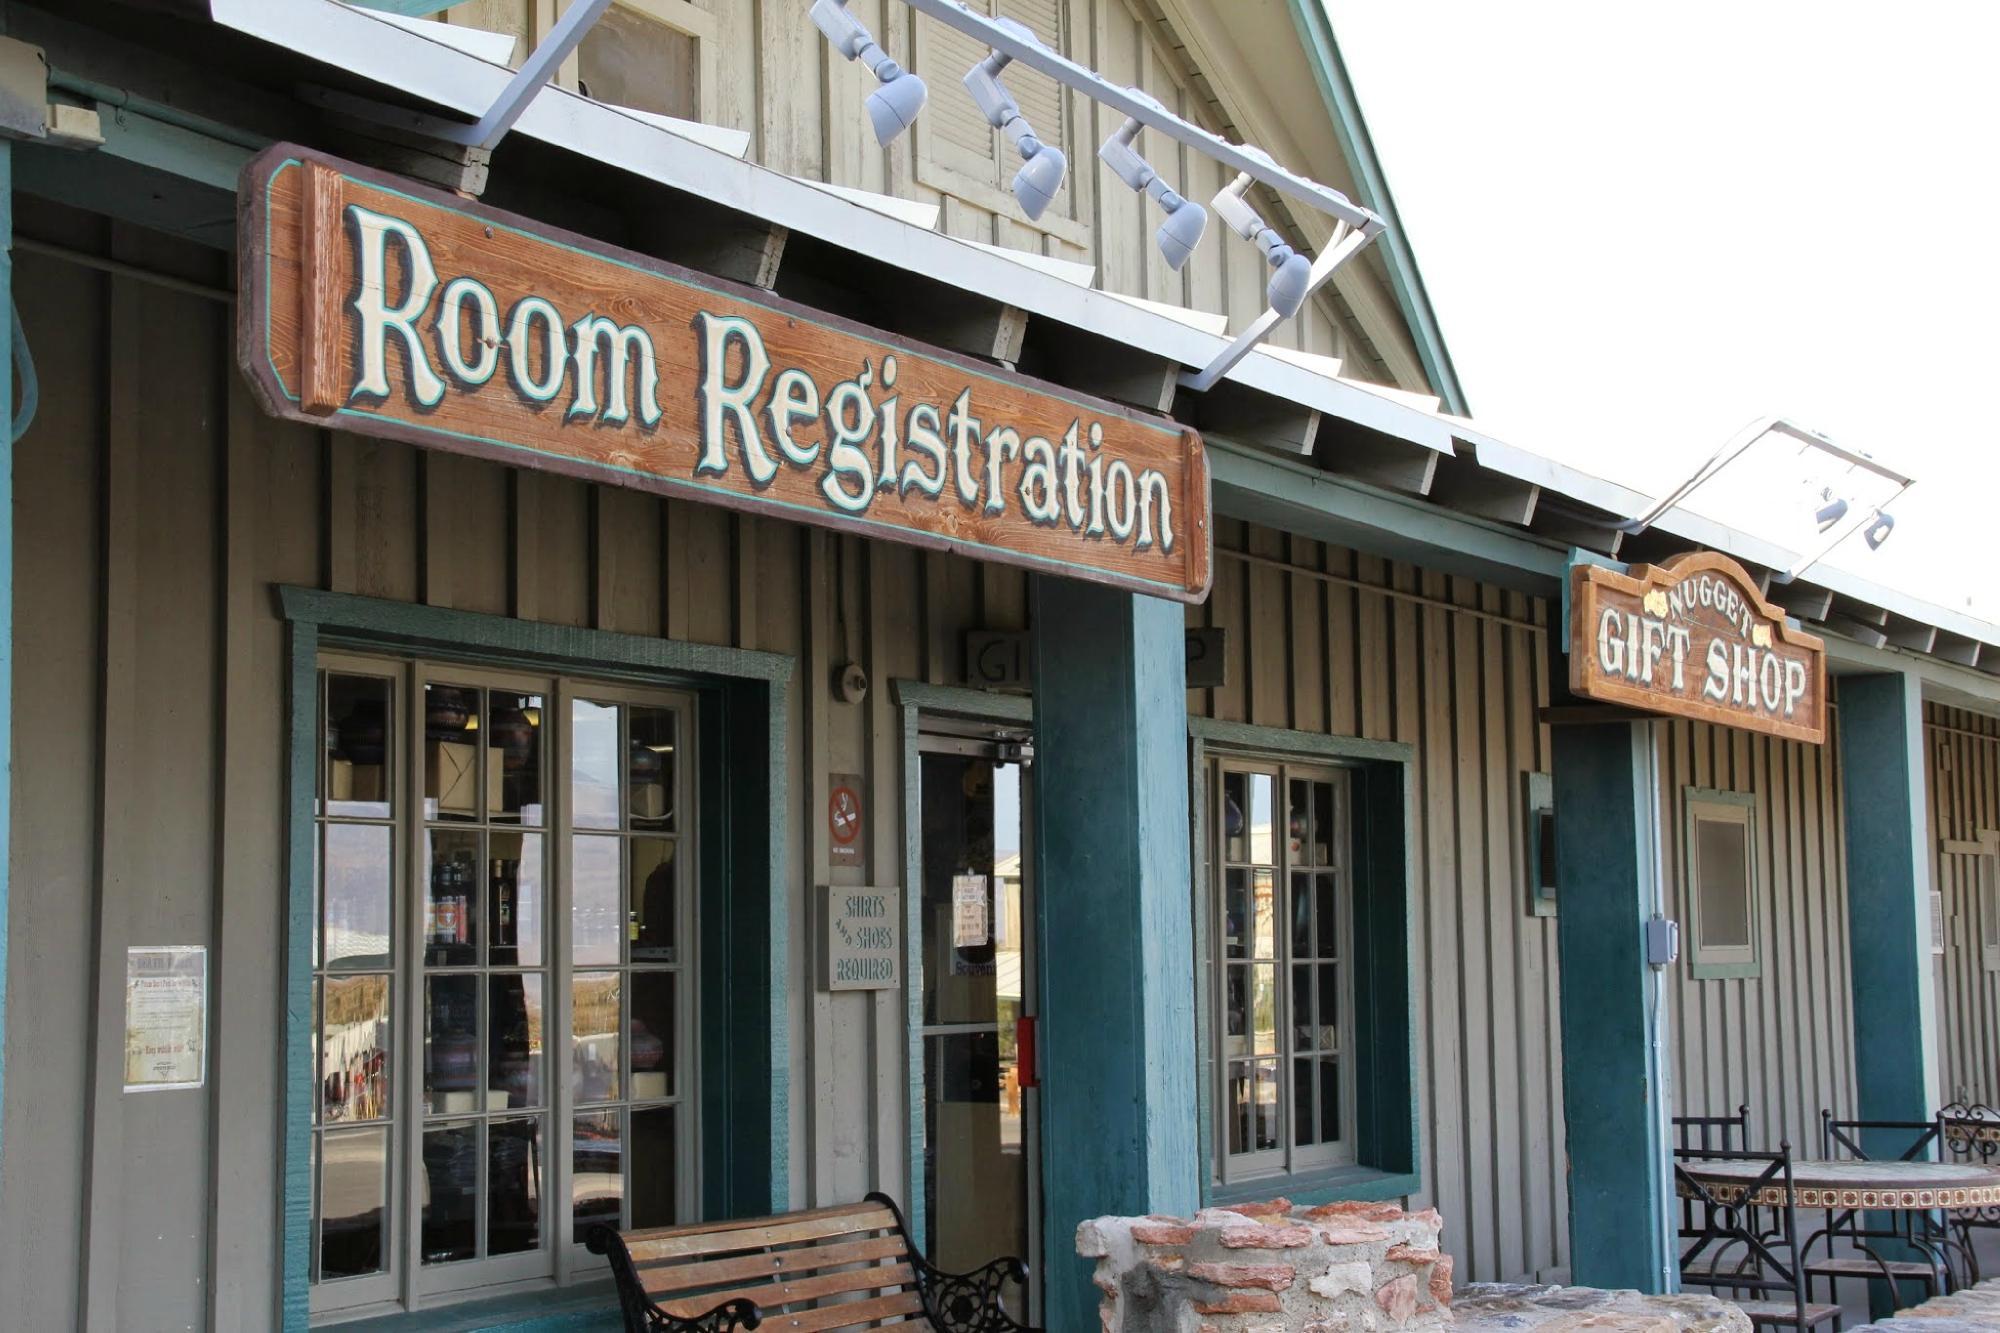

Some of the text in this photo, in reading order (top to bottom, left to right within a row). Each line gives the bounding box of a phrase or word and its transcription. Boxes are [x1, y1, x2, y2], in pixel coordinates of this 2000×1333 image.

[347, 204, 1175, 553] Room Registration
[1668, 575, 1753, 639] NUGGET
[1597, 607, 1806, 717] GIFT SHOP
[845, 895, 885, 918] SHIRTS
[835, 918, 893, 949] AND SHOES
[837, 958, 893, 981] REQUIRED
